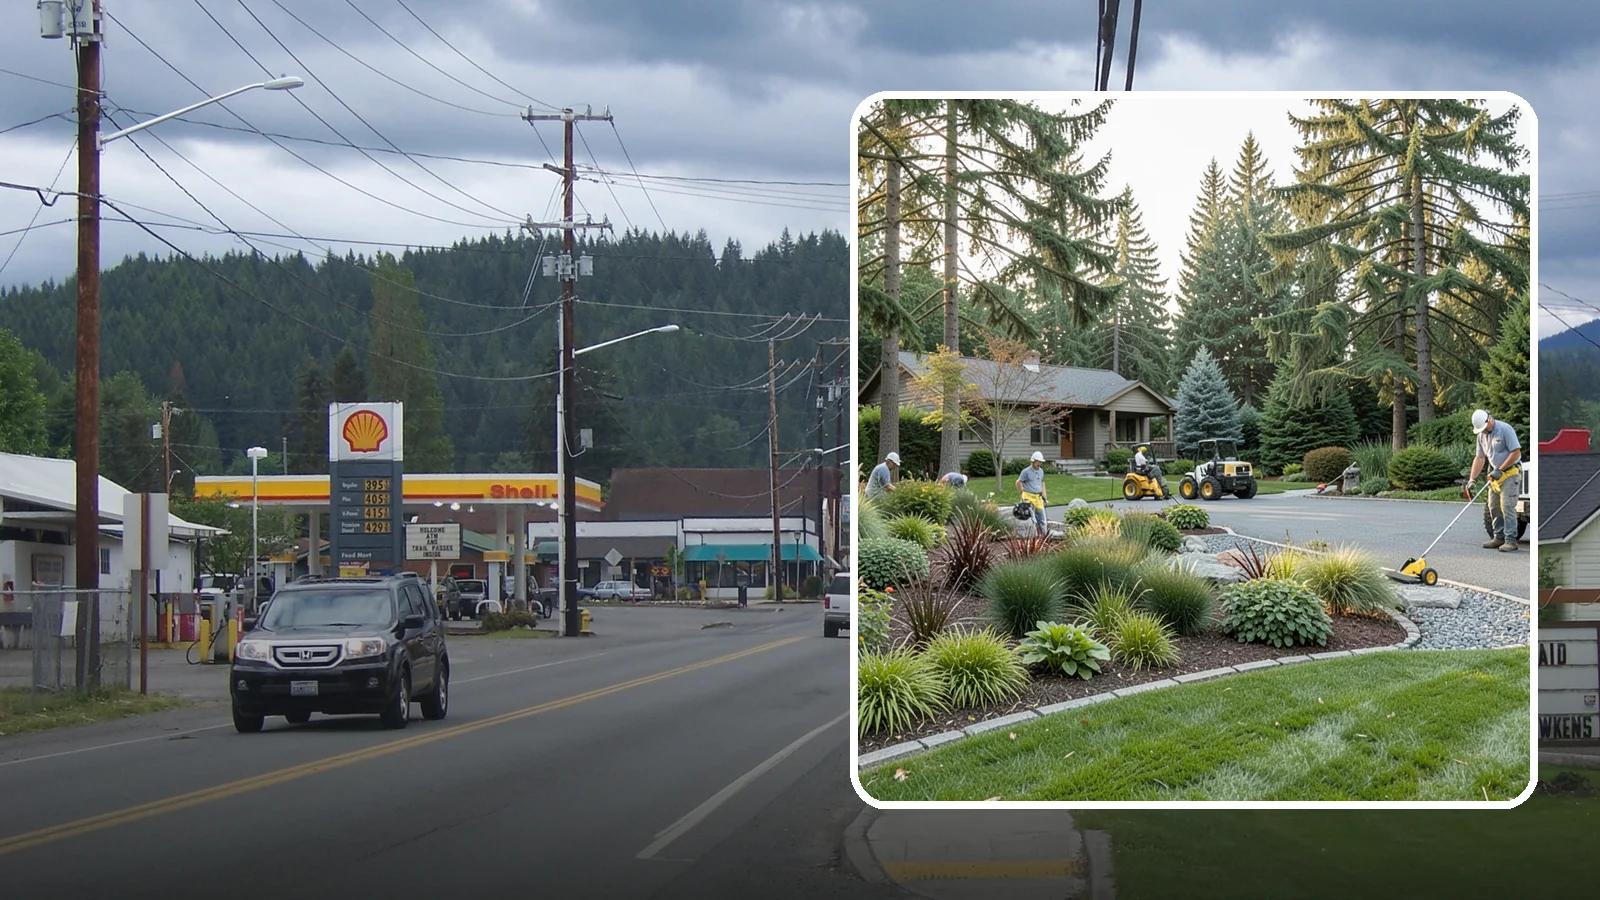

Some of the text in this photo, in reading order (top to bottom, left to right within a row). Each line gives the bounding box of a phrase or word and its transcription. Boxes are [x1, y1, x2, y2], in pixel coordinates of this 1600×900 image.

[366, 480, 383, 490] 395
[490, 484, 547, 499] Shell
[366, 494, 383, 504] 405
[366, 508, 383, 518] 415
[366, 522, 383, 532] 429
[1538, 642, 1567, 666] AID
[1538, 715, 1592, 739] WKENS
